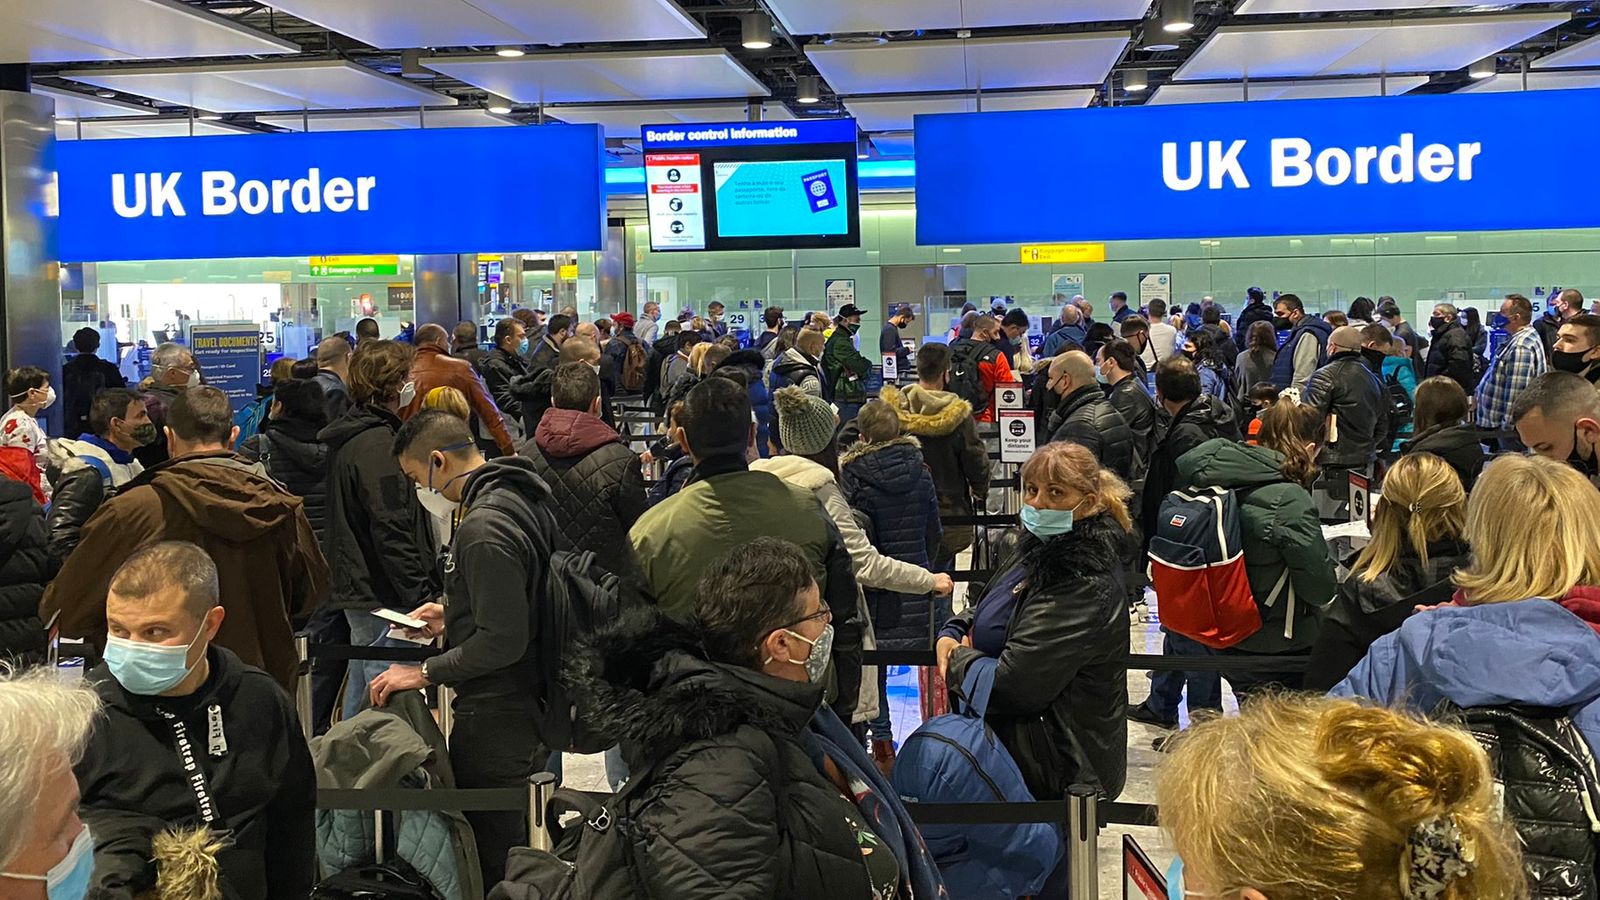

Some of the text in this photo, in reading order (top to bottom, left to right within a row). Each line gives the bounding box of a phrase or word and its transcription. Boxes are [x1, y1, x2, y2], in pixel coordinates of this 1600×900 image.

[646, 126, 798, 142] Border control information
[1160, 133, 1481, 191] UK Border
[803, 172, 828, 183] PASSPORT
[111, 168, 376, 218] UK Border
[730, 314, 744, 323] 29
[164, 323, 176, 332] 21
[194, 335, 258, 348] TRAVEL DOCUMENTS
[259, 332, 274, 343] 25
[1030, 338, 1039, 346] 32
[205, 348, 220, 356] ready
[174, 721, 196, 771] Firetrap
[191, 773, 214, 822] Firetrap
